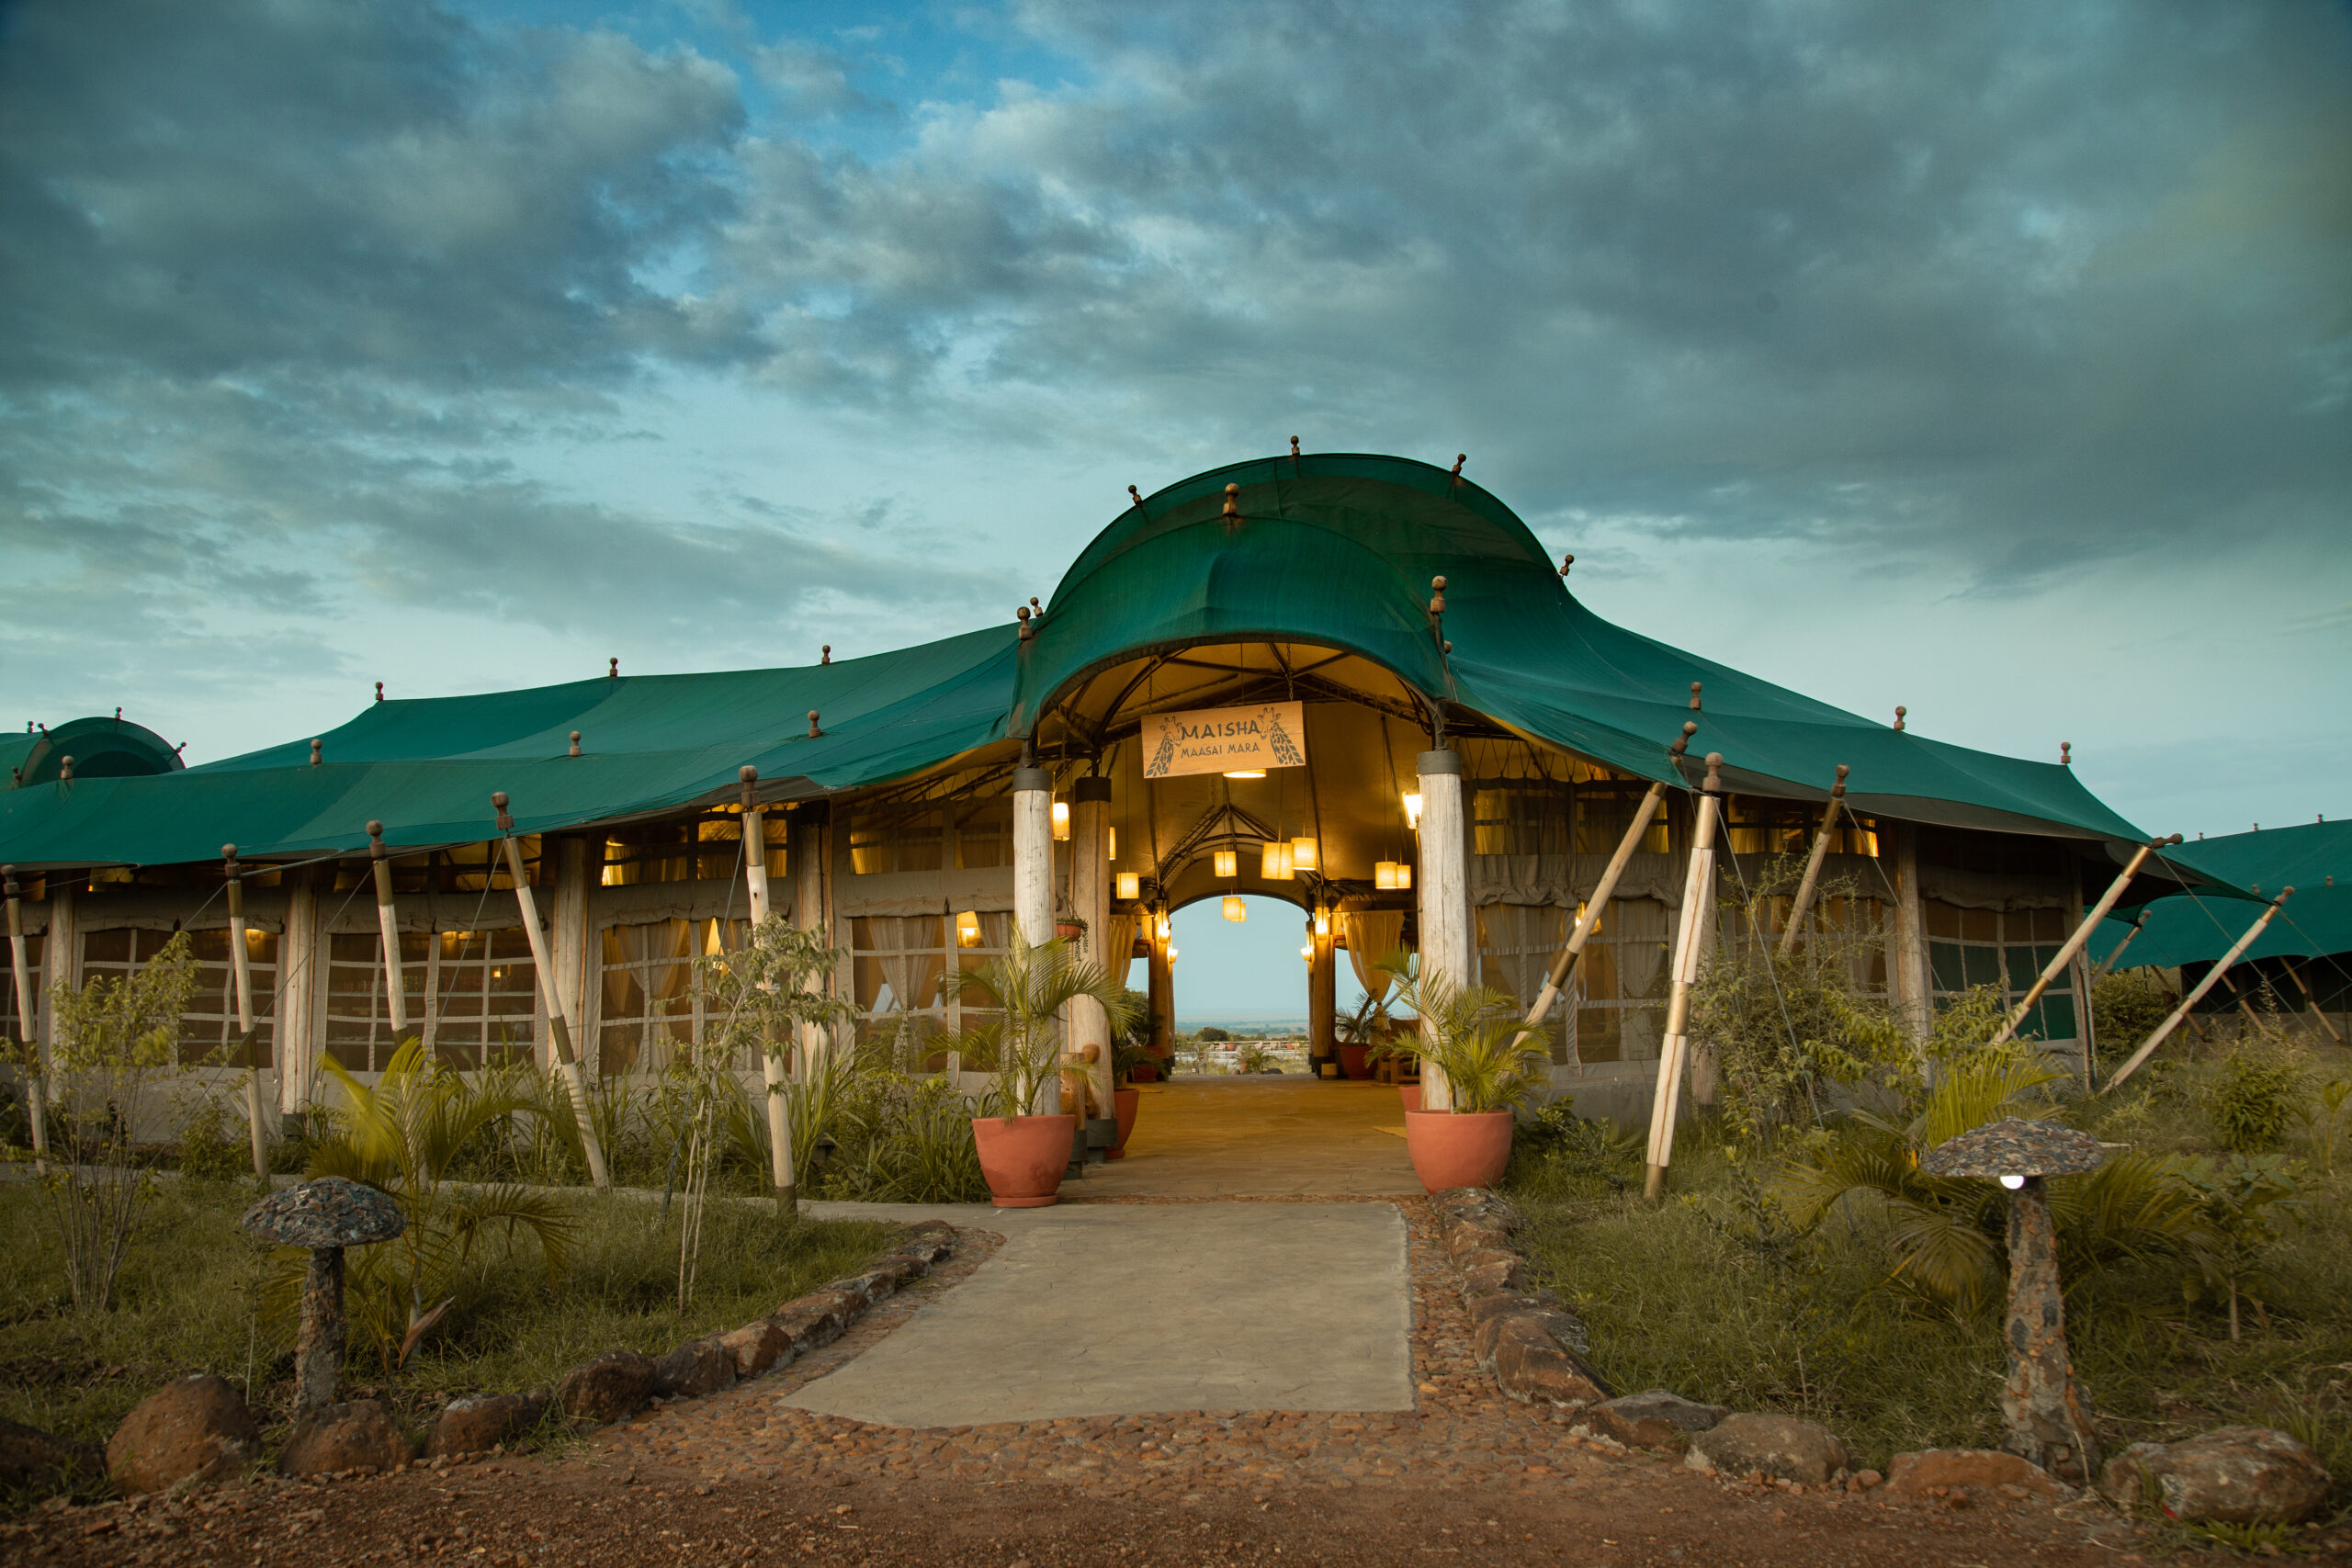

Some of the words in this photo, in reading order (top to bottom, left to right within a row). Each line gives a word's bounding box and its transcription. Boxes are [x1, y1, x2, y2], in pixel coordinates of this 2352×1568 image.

[1181, 719, 1261, 740] MAISHA
[1181, 745, 1223, 759] MAASAI
[1227, 742, 1261, 754] MARA
